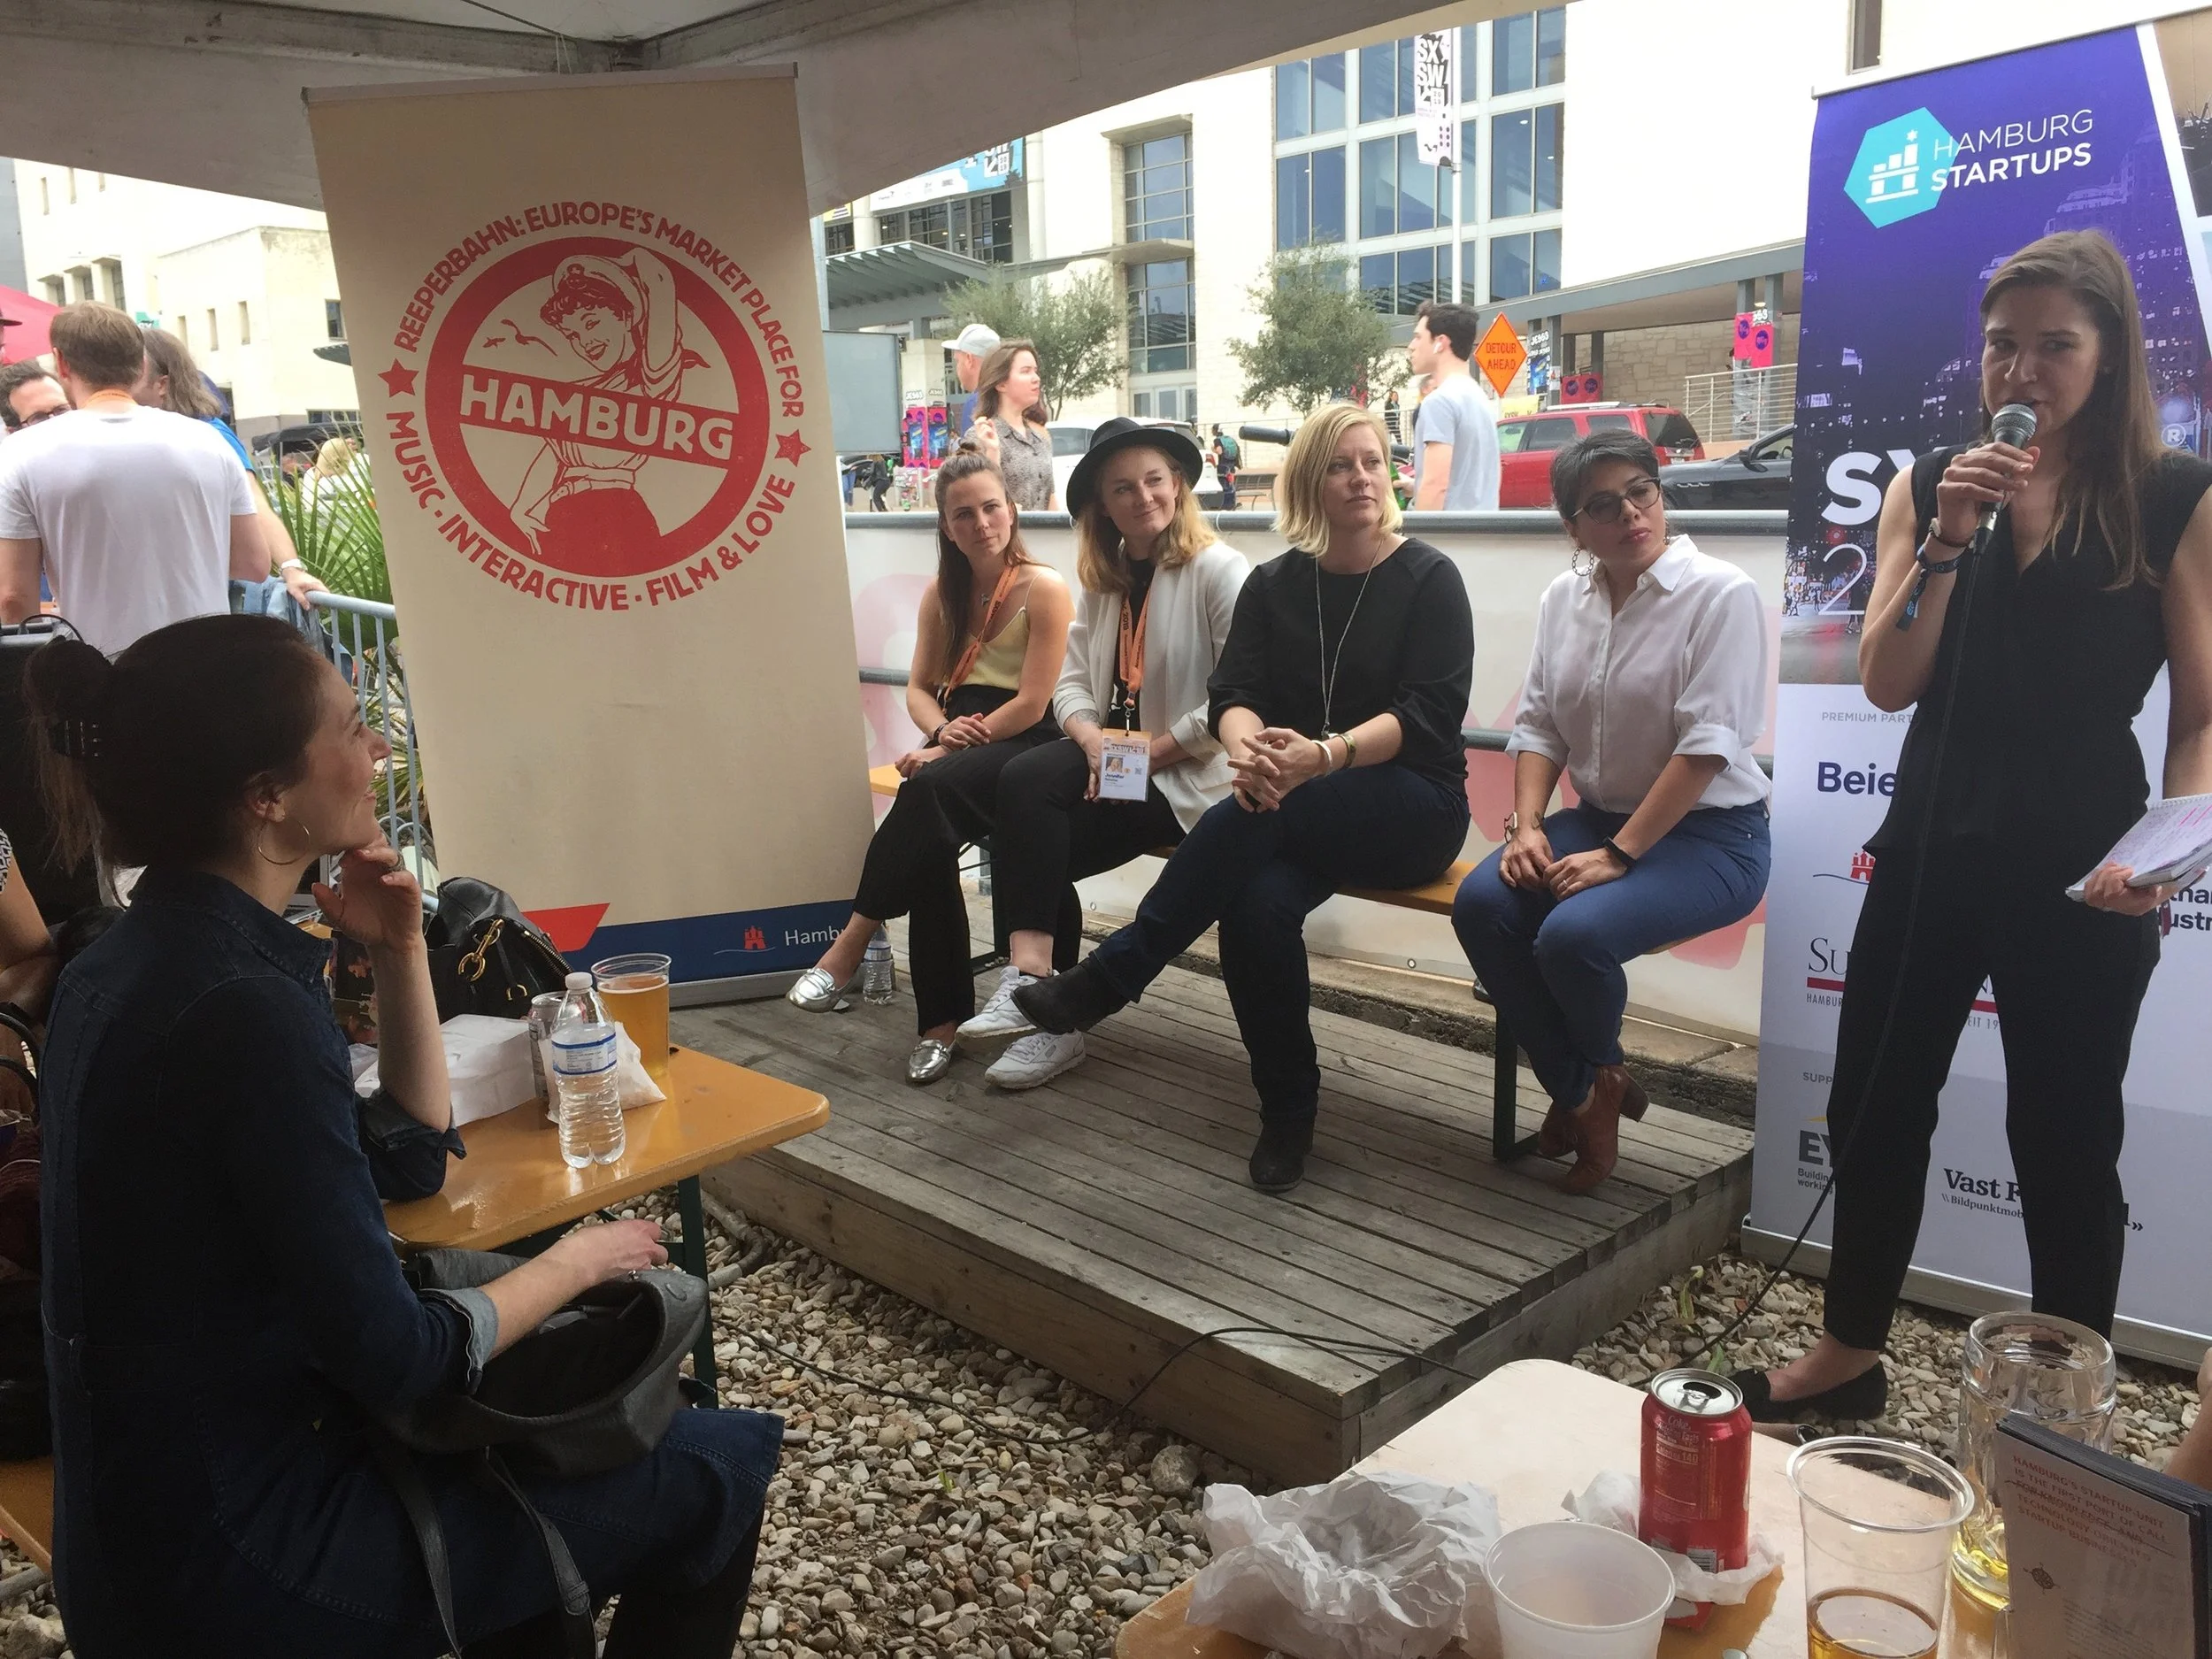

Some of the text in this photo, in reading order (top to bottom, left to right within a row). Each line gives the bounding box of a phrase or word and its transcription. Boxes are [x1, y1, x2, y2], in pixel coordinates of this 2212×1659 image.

[1933, 109, 2093, 161] HAMBURG
[1931, 142, 2093, 192] STARTUPS
[394, 213, 526, 352] REEPERBAHN:
[528, 202, 655, 233] EUROPE'S
[776, 366, 804, 418] FOR
[1486, 342, 1517, 354] DETOUR
[1486, 358, 1517, 370] AHEAD
[459, 373, 733, 460] HAMBURG
[386, 411, 795, 611] MUSIC INTERACTIVE FILM & LOVE
[1822, 711, 1877, 723] PREMIUM
[1798, 1168, 1831, 1182] Buildin
[1943, 1167, 2001, 1200] Vast
[2013, 1455, 2078, 1490] HAMBURG'S
[2015, 1468, 2166, 1543] IS THE FIRST PORT OF CALL
[2018, 1505, 2066, 1534] STARTUP
